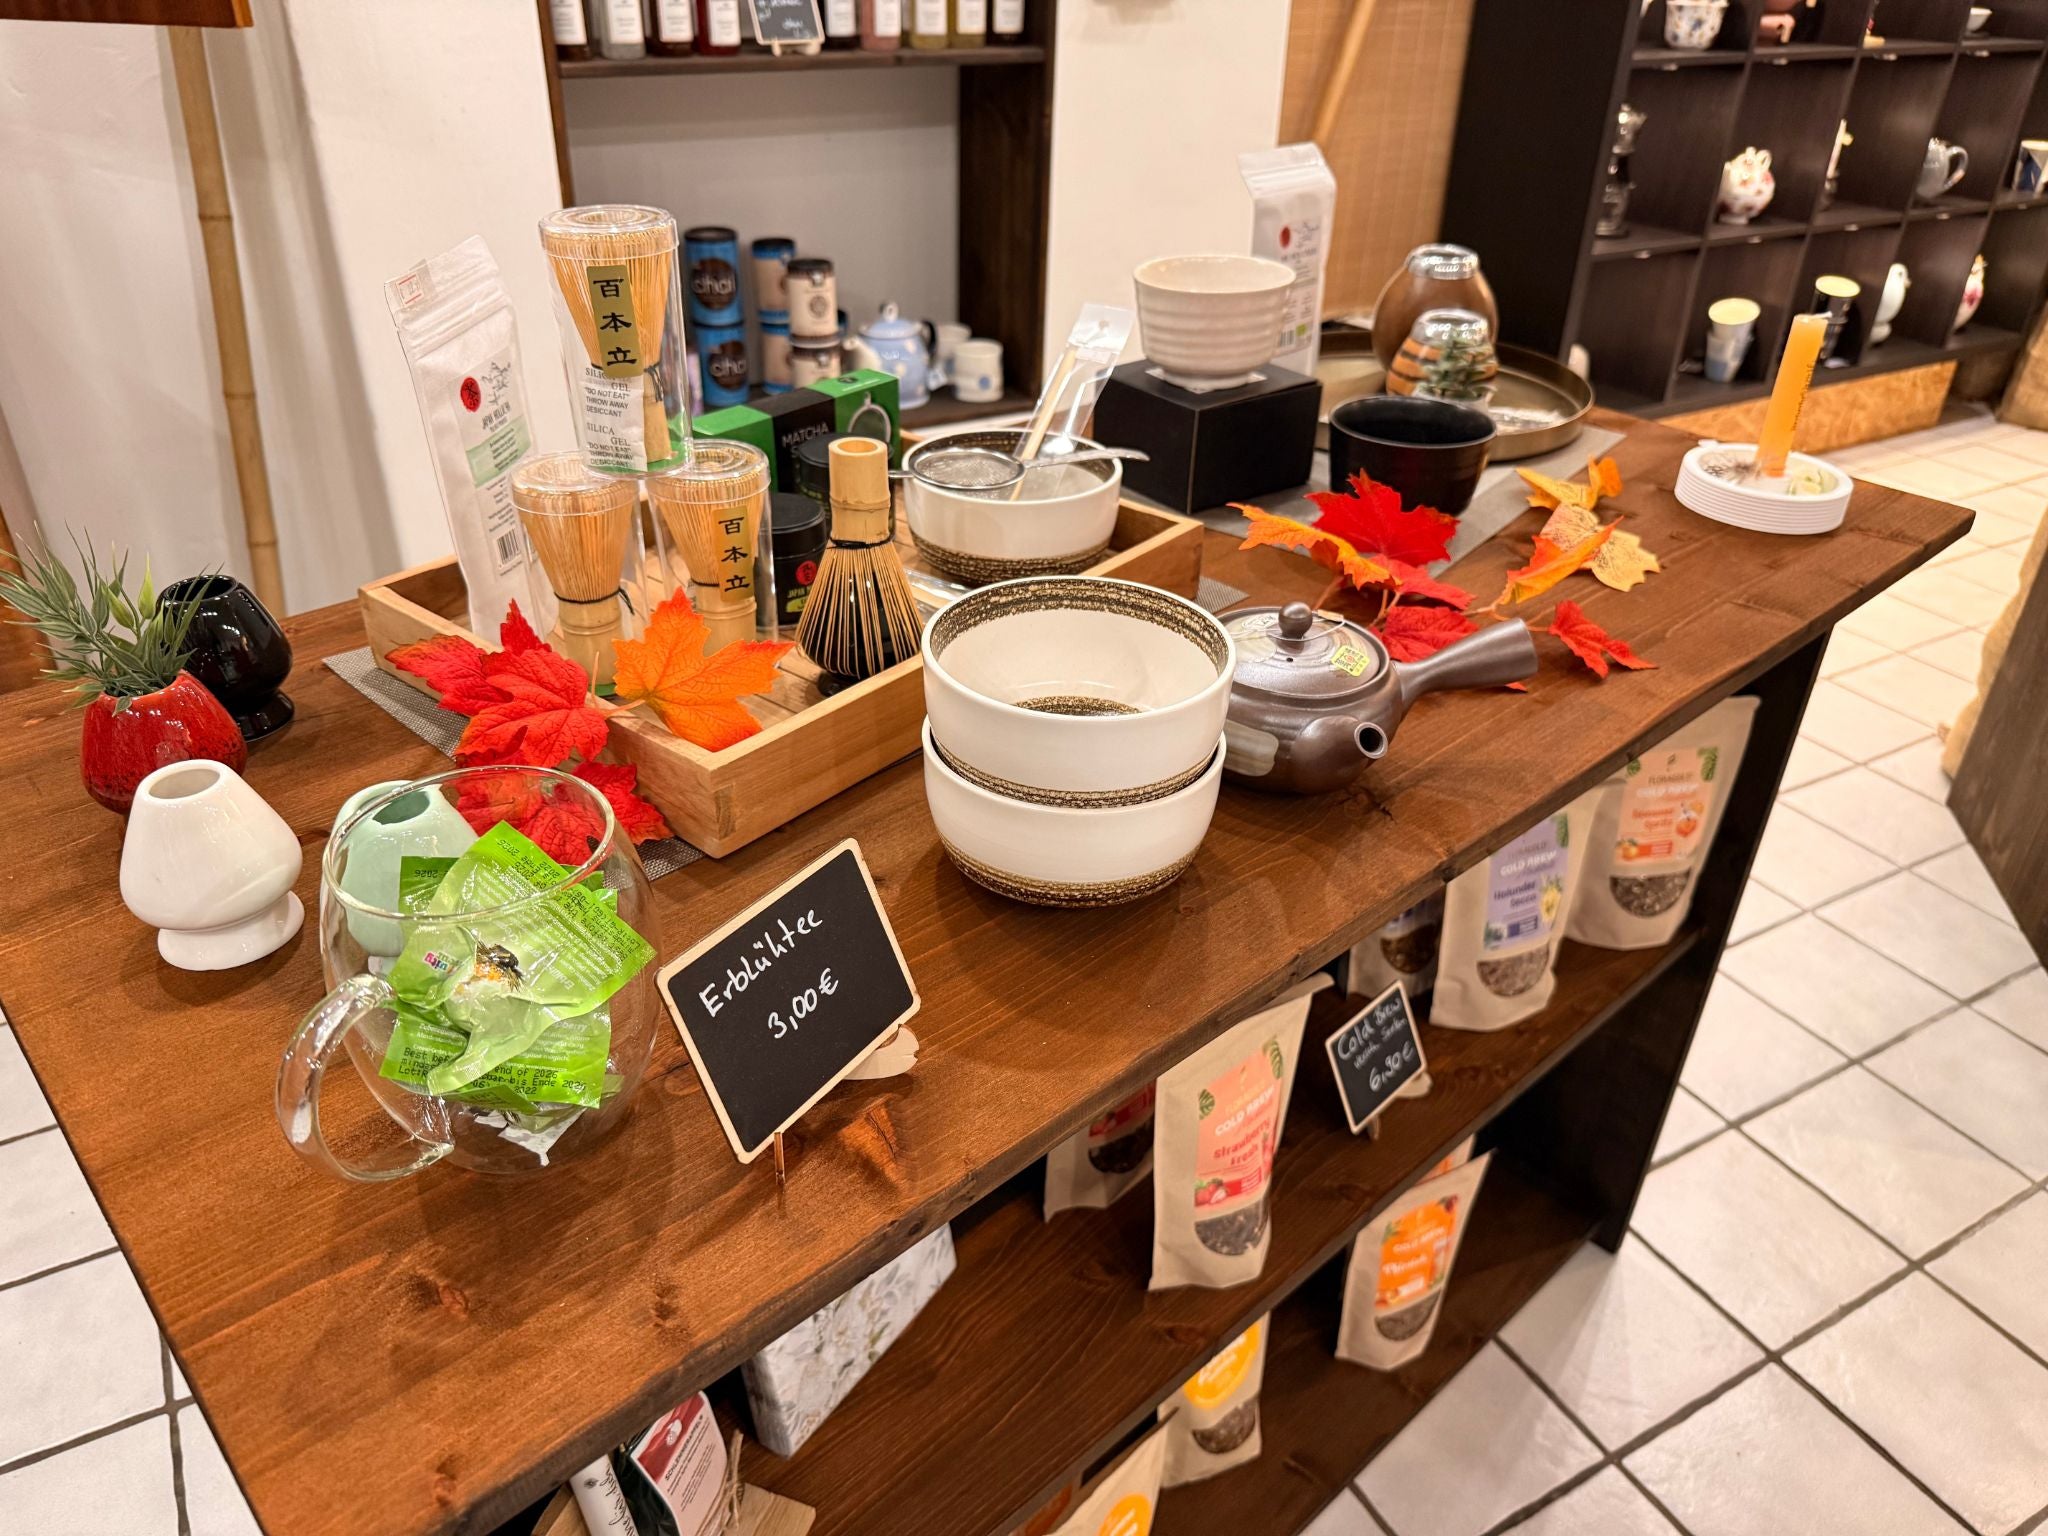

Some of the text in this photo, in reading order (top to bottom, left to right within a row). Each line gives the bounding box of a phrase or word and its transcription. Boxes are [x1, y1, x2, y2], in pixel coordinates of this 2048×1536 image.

[593, 278, 637, 366] 百本立
[598, 388, 612, 399] NOT
[611, 382, 631, 392] GEL
[586, 396, 629, 410] THROW AWAY
[586, 406, 622, 418] DESICCANT
[587, 422, 615, 435] SILICA
[782, 422, 829, 448] MATCHA
[611, 436, 631, 447] GEL
[718, 516, 751, 593] 百本立
[497, 839, 519, 857] 2026
[521, 855, 539, 874] Ende
[1338, 1016, 1375, 1060] Cold
[404, 1047, 428, 1060] Best
[517, 1067, 529, 1077] of
[534, 1068, 558, 1079] 2026
[532, 1077, 555, 1087] Ende
[1215, 1111, 1246, 1136] COLD
[1213, 1118, 1271, 1159] Strawberry
[1230, 1143, 1259, 1166] Fresh
